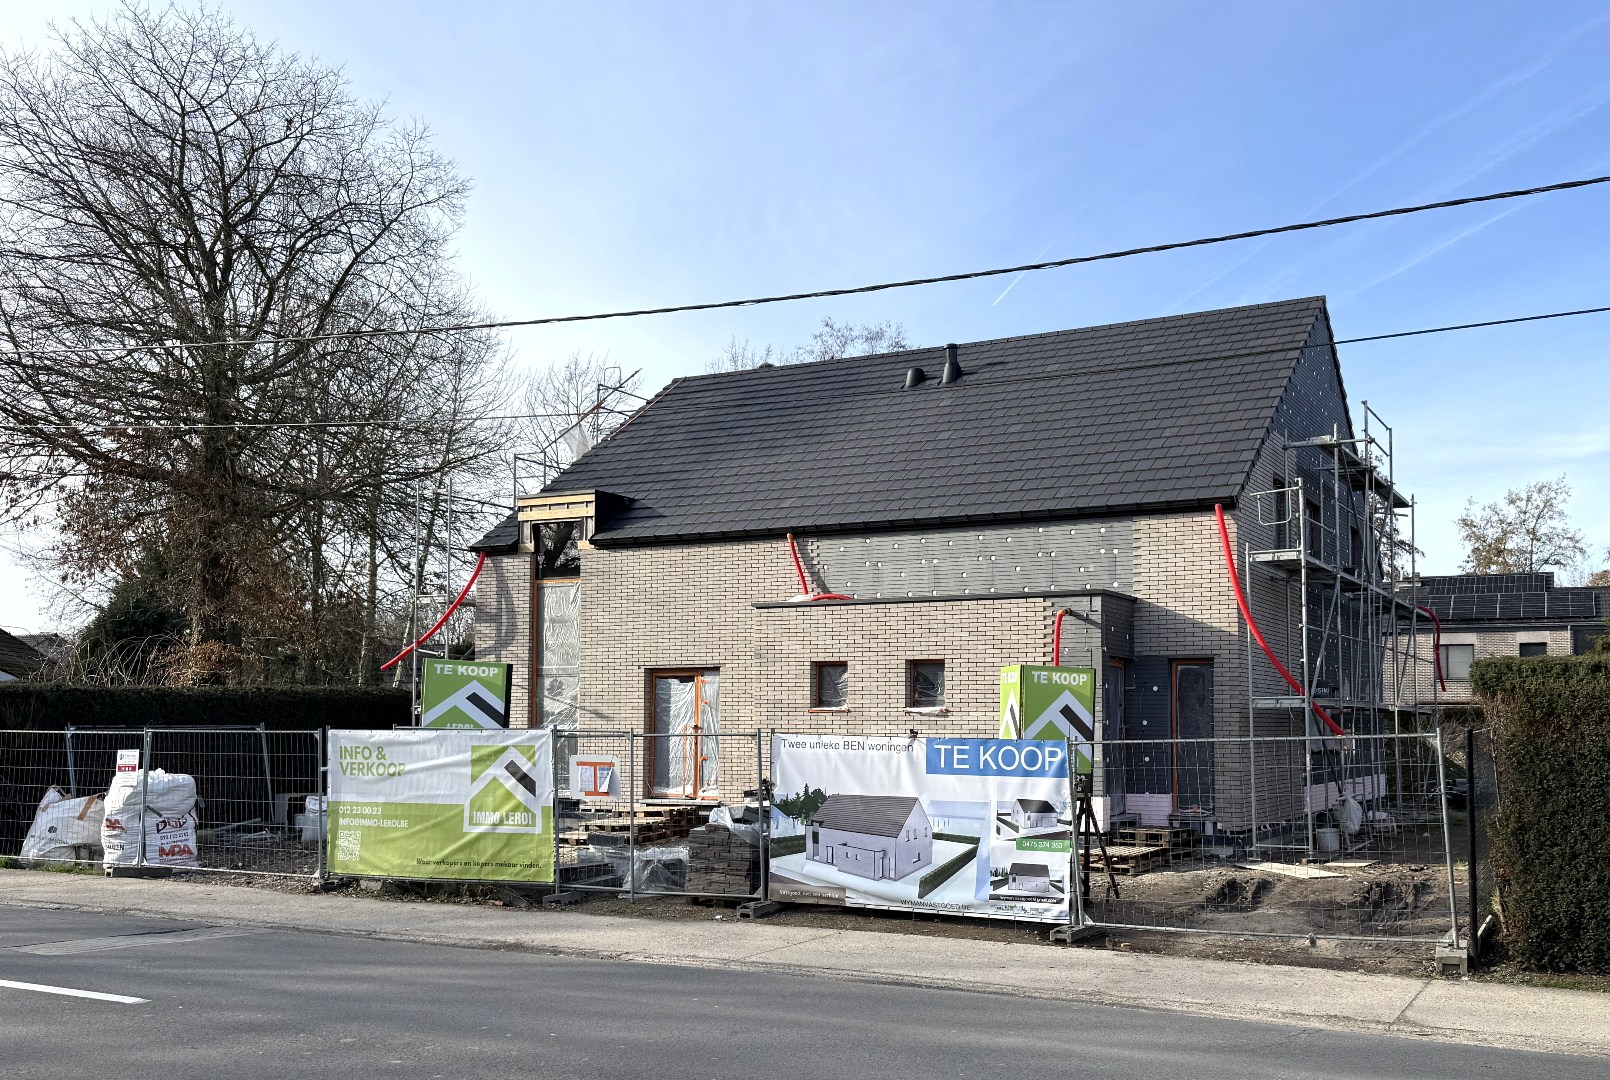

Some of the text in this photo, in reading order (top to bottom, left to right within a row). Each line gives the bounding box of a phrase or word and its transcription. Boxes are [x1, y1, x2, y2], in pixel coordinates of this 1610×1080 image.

[434, 663, 499, 677] TE KOOP
[1031, 671, 1088, 686] TE KOOP
[339, 745, 388, 761] INFO &
[782, 738, 914, 755] Twee unieke BEN woningen
[934, 744, 1063, 772] TE KOOP
[339, 761, 407, 777] VERKOOP
[339, 805, 382, 815] 012 23 00 23
[473, 810, 532, 825] IMMO LEROI
[339, 817, 409, 828] INFO@IMMO-LEROI.BE
